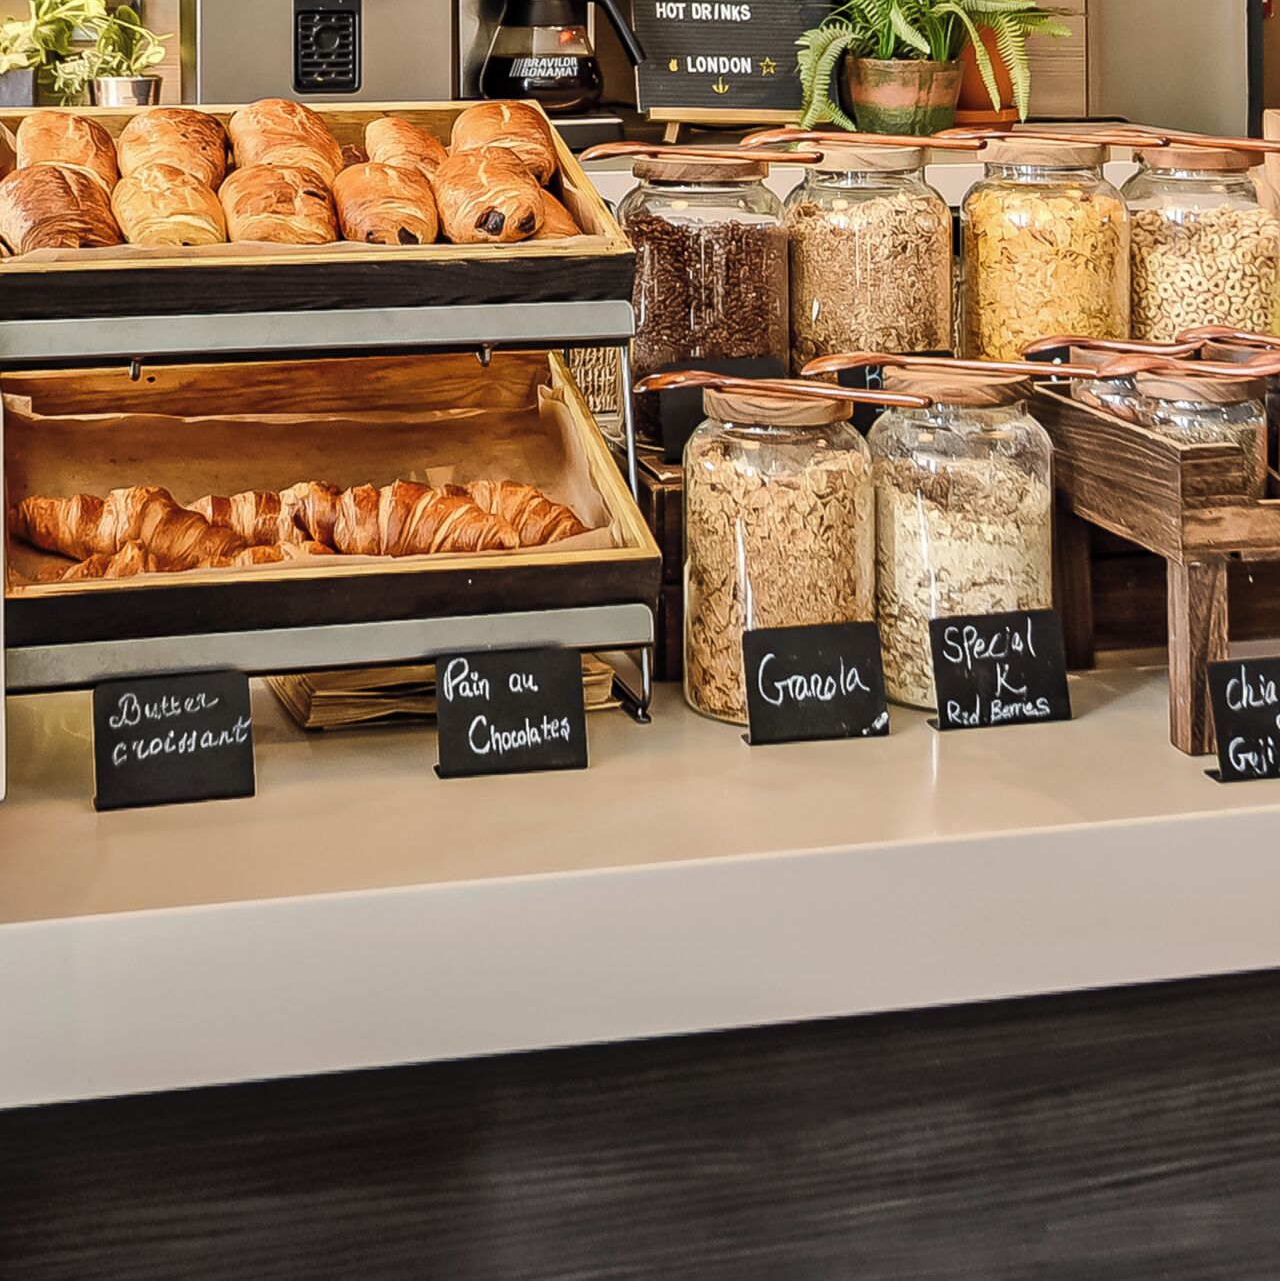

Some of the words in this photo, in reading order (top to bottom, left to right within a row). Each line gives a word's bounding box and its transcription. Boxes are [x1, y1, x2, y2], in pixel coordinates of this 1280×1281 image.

[656, 2, 687, 19] HOT
[691, 2, 752, 22] DRINKS
[520, 67, 577, 77] BONAMAT
[523, 57, 577, 67] BRAVILOR
[686, 56, 752, 74] LONDON
[443, 657, 489, 703] Pain
[509, 673, 538, 693] au
[758, 653, 870, 705] Granola
[995, 663, 1028, 697] K
[109, 693, 219, 728] Butter
[990, 697, 1050, 724] Berries
[468, 715, 570, 756] Chocolates
